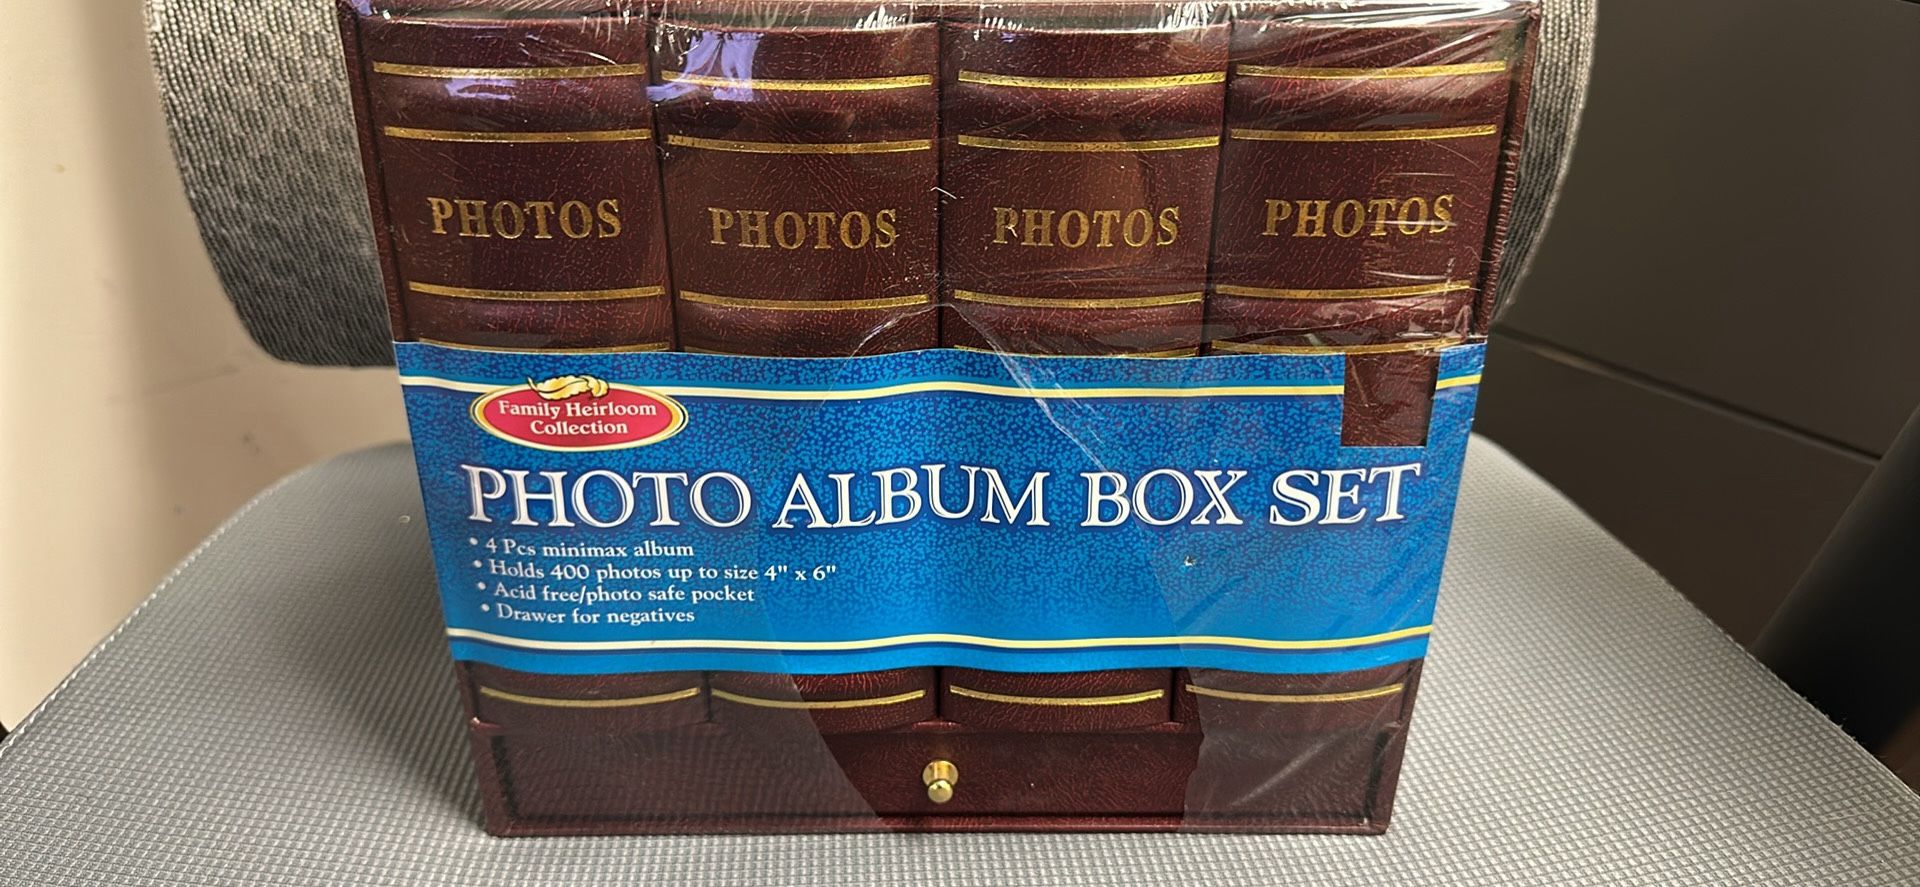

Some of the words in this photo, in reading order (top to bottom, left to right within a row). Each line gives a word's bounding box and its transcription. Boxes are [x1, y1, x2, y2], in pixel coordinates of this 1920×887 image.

[426, 196, 623, 239] PHOTOS
[707, 207, 898, 249] PHOTOS
[992, 205, 1182, 248] PHOTOS
[1262, 194, 1455, 238] PHOTOS
[498, 400, 560, 418] Family
[566, 401, 657, 417] Heirloom
[530, 420, 628, 435] Collection
[461, 464, 751, 528] PHOTO
[771, 464, 1048, 530] ALBUM
[1080, 469, 1244, 528] BOX
[1268, 463, 1421, 526] SET
[485, 538, 498, 555] 4
[504, 539, 536, 557] Pcs
[543, 543, 626, 557] minimax
[634, 541, 694, 557] album
[489, 560, 545, 579] Holds
[550, 563, 590, 580] 400
[597, 564, 661, 583] photos
[668, 568, 693, 583] up
[699, 566, 718, 580] to
[724, 566, 758, 580] size
[764, 564, 788, 580] 4"
[795, 569, 806, 581] x
[813, 564, 837, 581] 6"
[493, 581, 537, 601] Acid
[542, 583, 642, 605] free/photo
[648, 584, 686, 601] safe
[692, 585, 755, 605] pocket
[497, 603, 566, 624] Drawer
[572, 607, 601, 624] for
[607, 608, 695, 626] negatives
